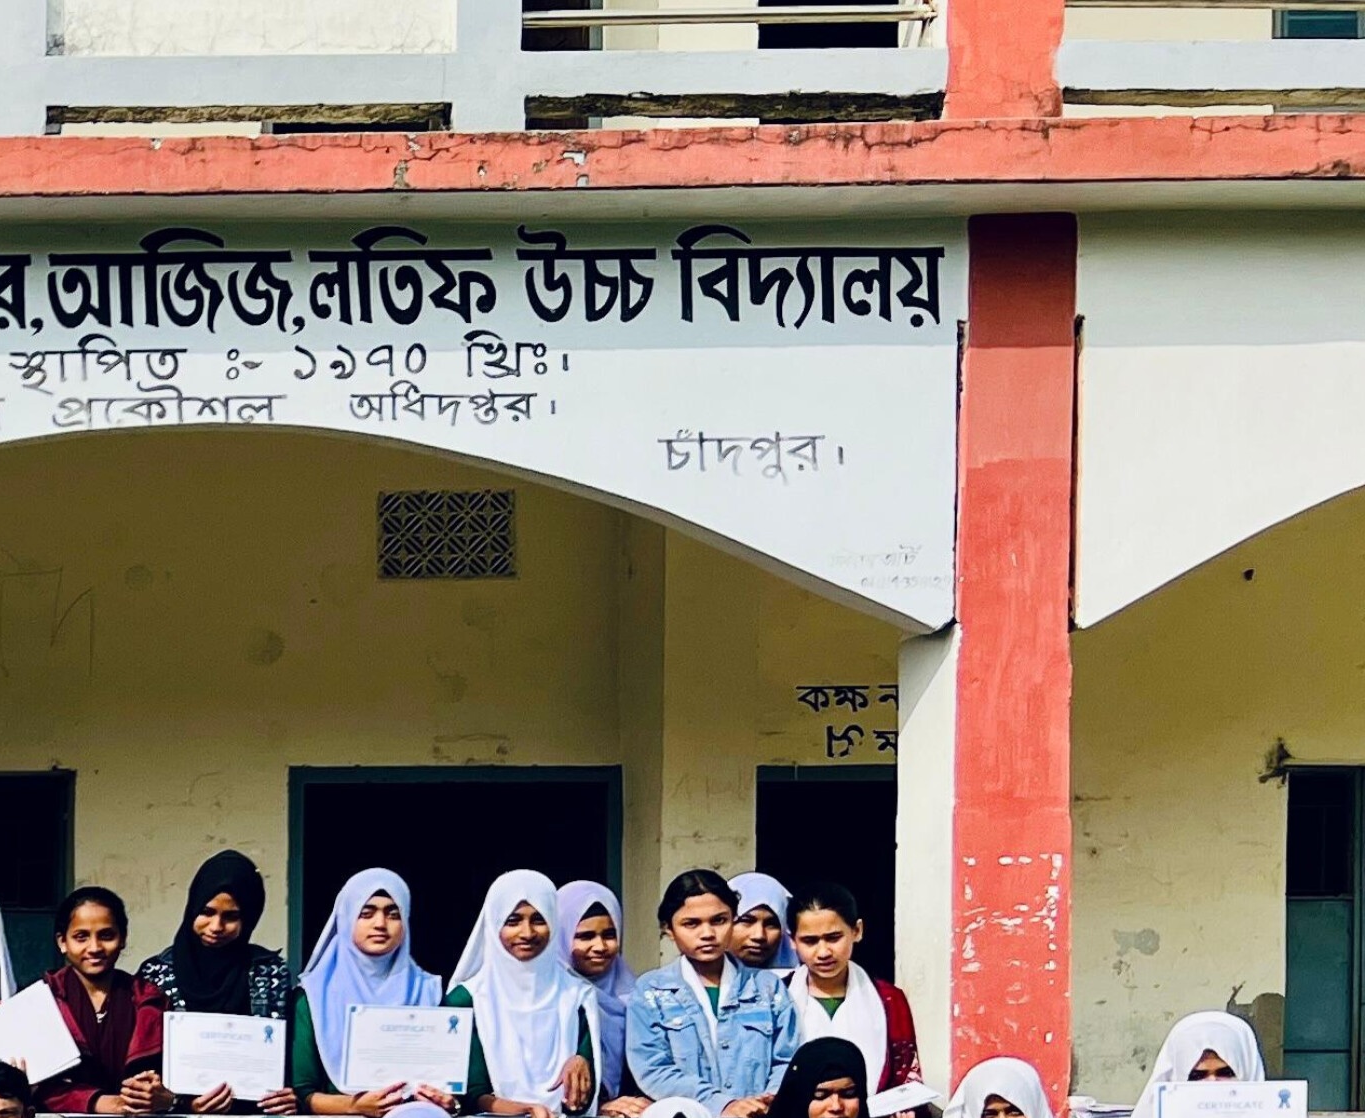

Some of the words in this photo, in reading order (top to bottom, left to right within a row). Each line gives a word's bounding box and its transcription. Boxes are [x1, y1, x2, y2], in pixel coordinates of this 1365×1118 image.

[516, 224, 657, 323] উচ্চ
[670, 224, 945, 329] বিদ্যালয়
[796, 685, 870, 713] কক্ষ
